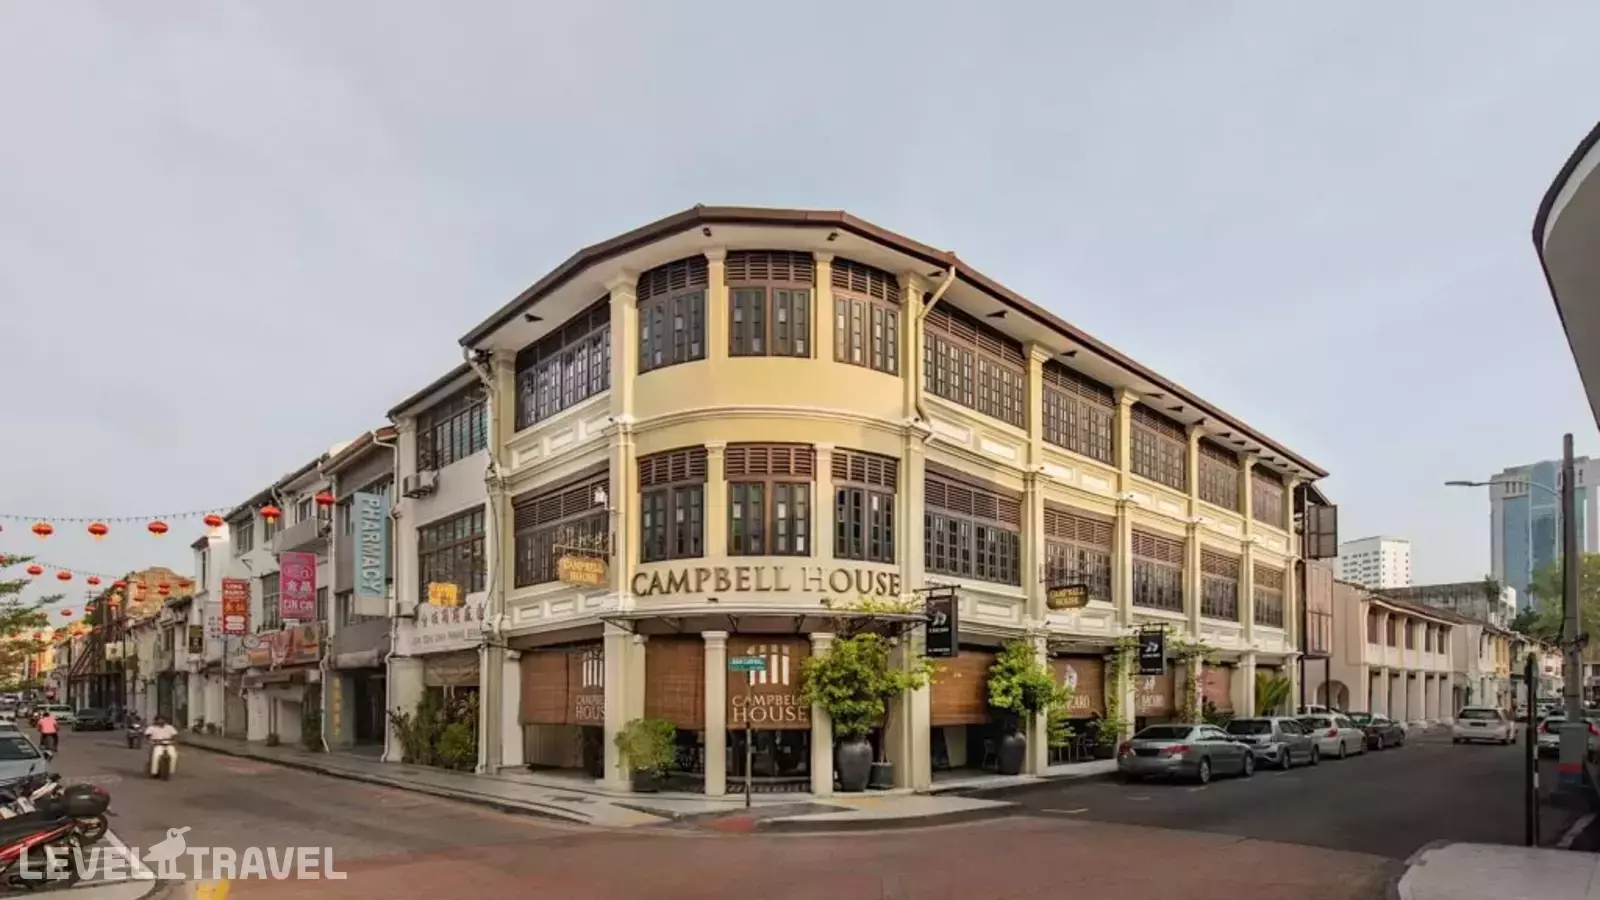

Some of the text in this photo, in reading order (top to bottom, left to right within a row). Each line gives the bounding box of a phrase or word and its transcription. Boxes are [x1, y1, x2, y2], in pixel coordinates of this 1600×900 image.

[361, 498, 382, 594] PHARMACY
[562, 559, 603, 573] CAMPBELL
[631, 566, 901, 597] CAMPBELL HOUSE
[575, 694, 605, 705] CAMPBE
[732, 695, 804, 707] CAMPBEL
[575, 705, 605, 720] HOUS
[733, 705, 808, 722] HOUSE
